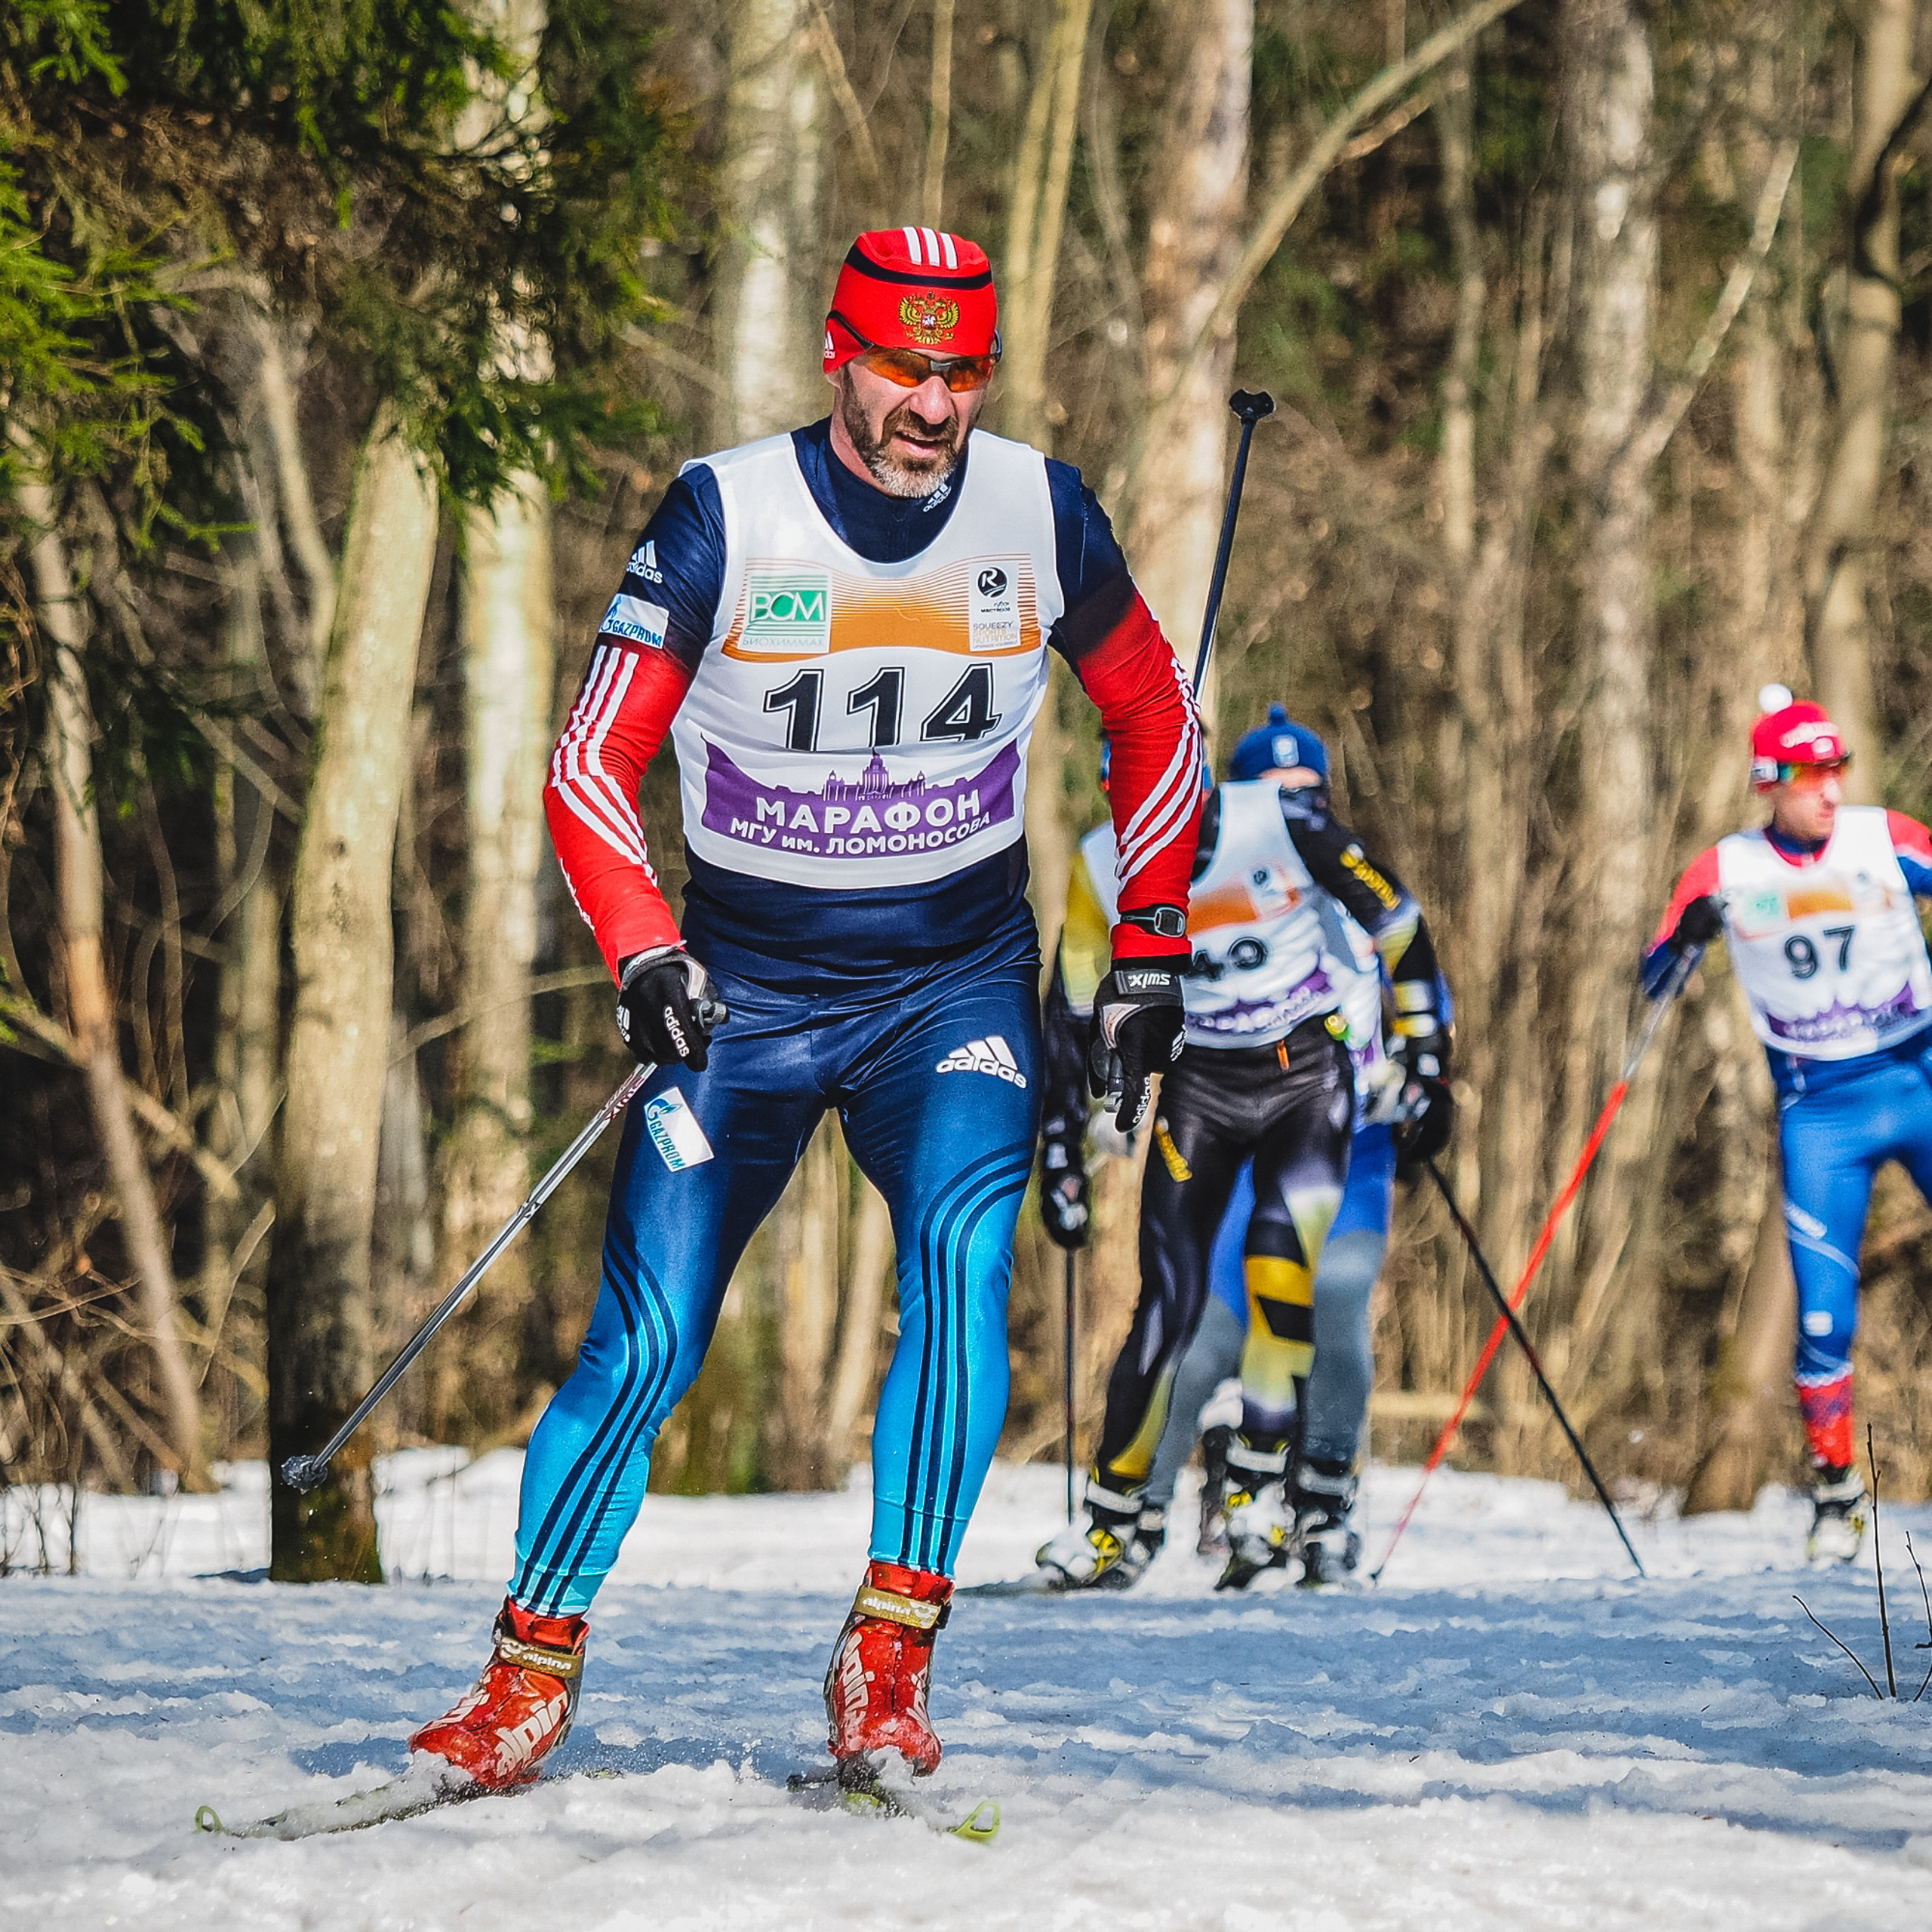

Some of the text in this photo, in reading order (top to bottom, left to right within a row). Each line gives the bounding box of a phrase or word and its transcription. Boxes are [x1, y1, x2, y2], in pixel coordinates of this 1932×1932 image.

[612, 620, 663, 647] GAZPROM
[743, 636, 824, 648] БИОХИММАК
[973, 620, 1014, 630] SQUEEZY
[763, 663, 1002, 752] 114
[756, 789, 980, 834] МАРАФОН
[731, 817, 780, 844] МГУ
[825, 811, 990, 854] ЛОМОНОСОВА
[1784, 925, 1855, 979] 97
[1128, 973, 1171, 989] swix
[664, 1005, 690, 1057] adidas
[935, 1055, 1027, 1088] adidas
[1132, 1077, 1151, 1124] adidas
[650, 1121, 686, 1170] GAZPROM
[863, 1597, 910, 1615] alpina
[522, 1653, 572, 1670] alpina
